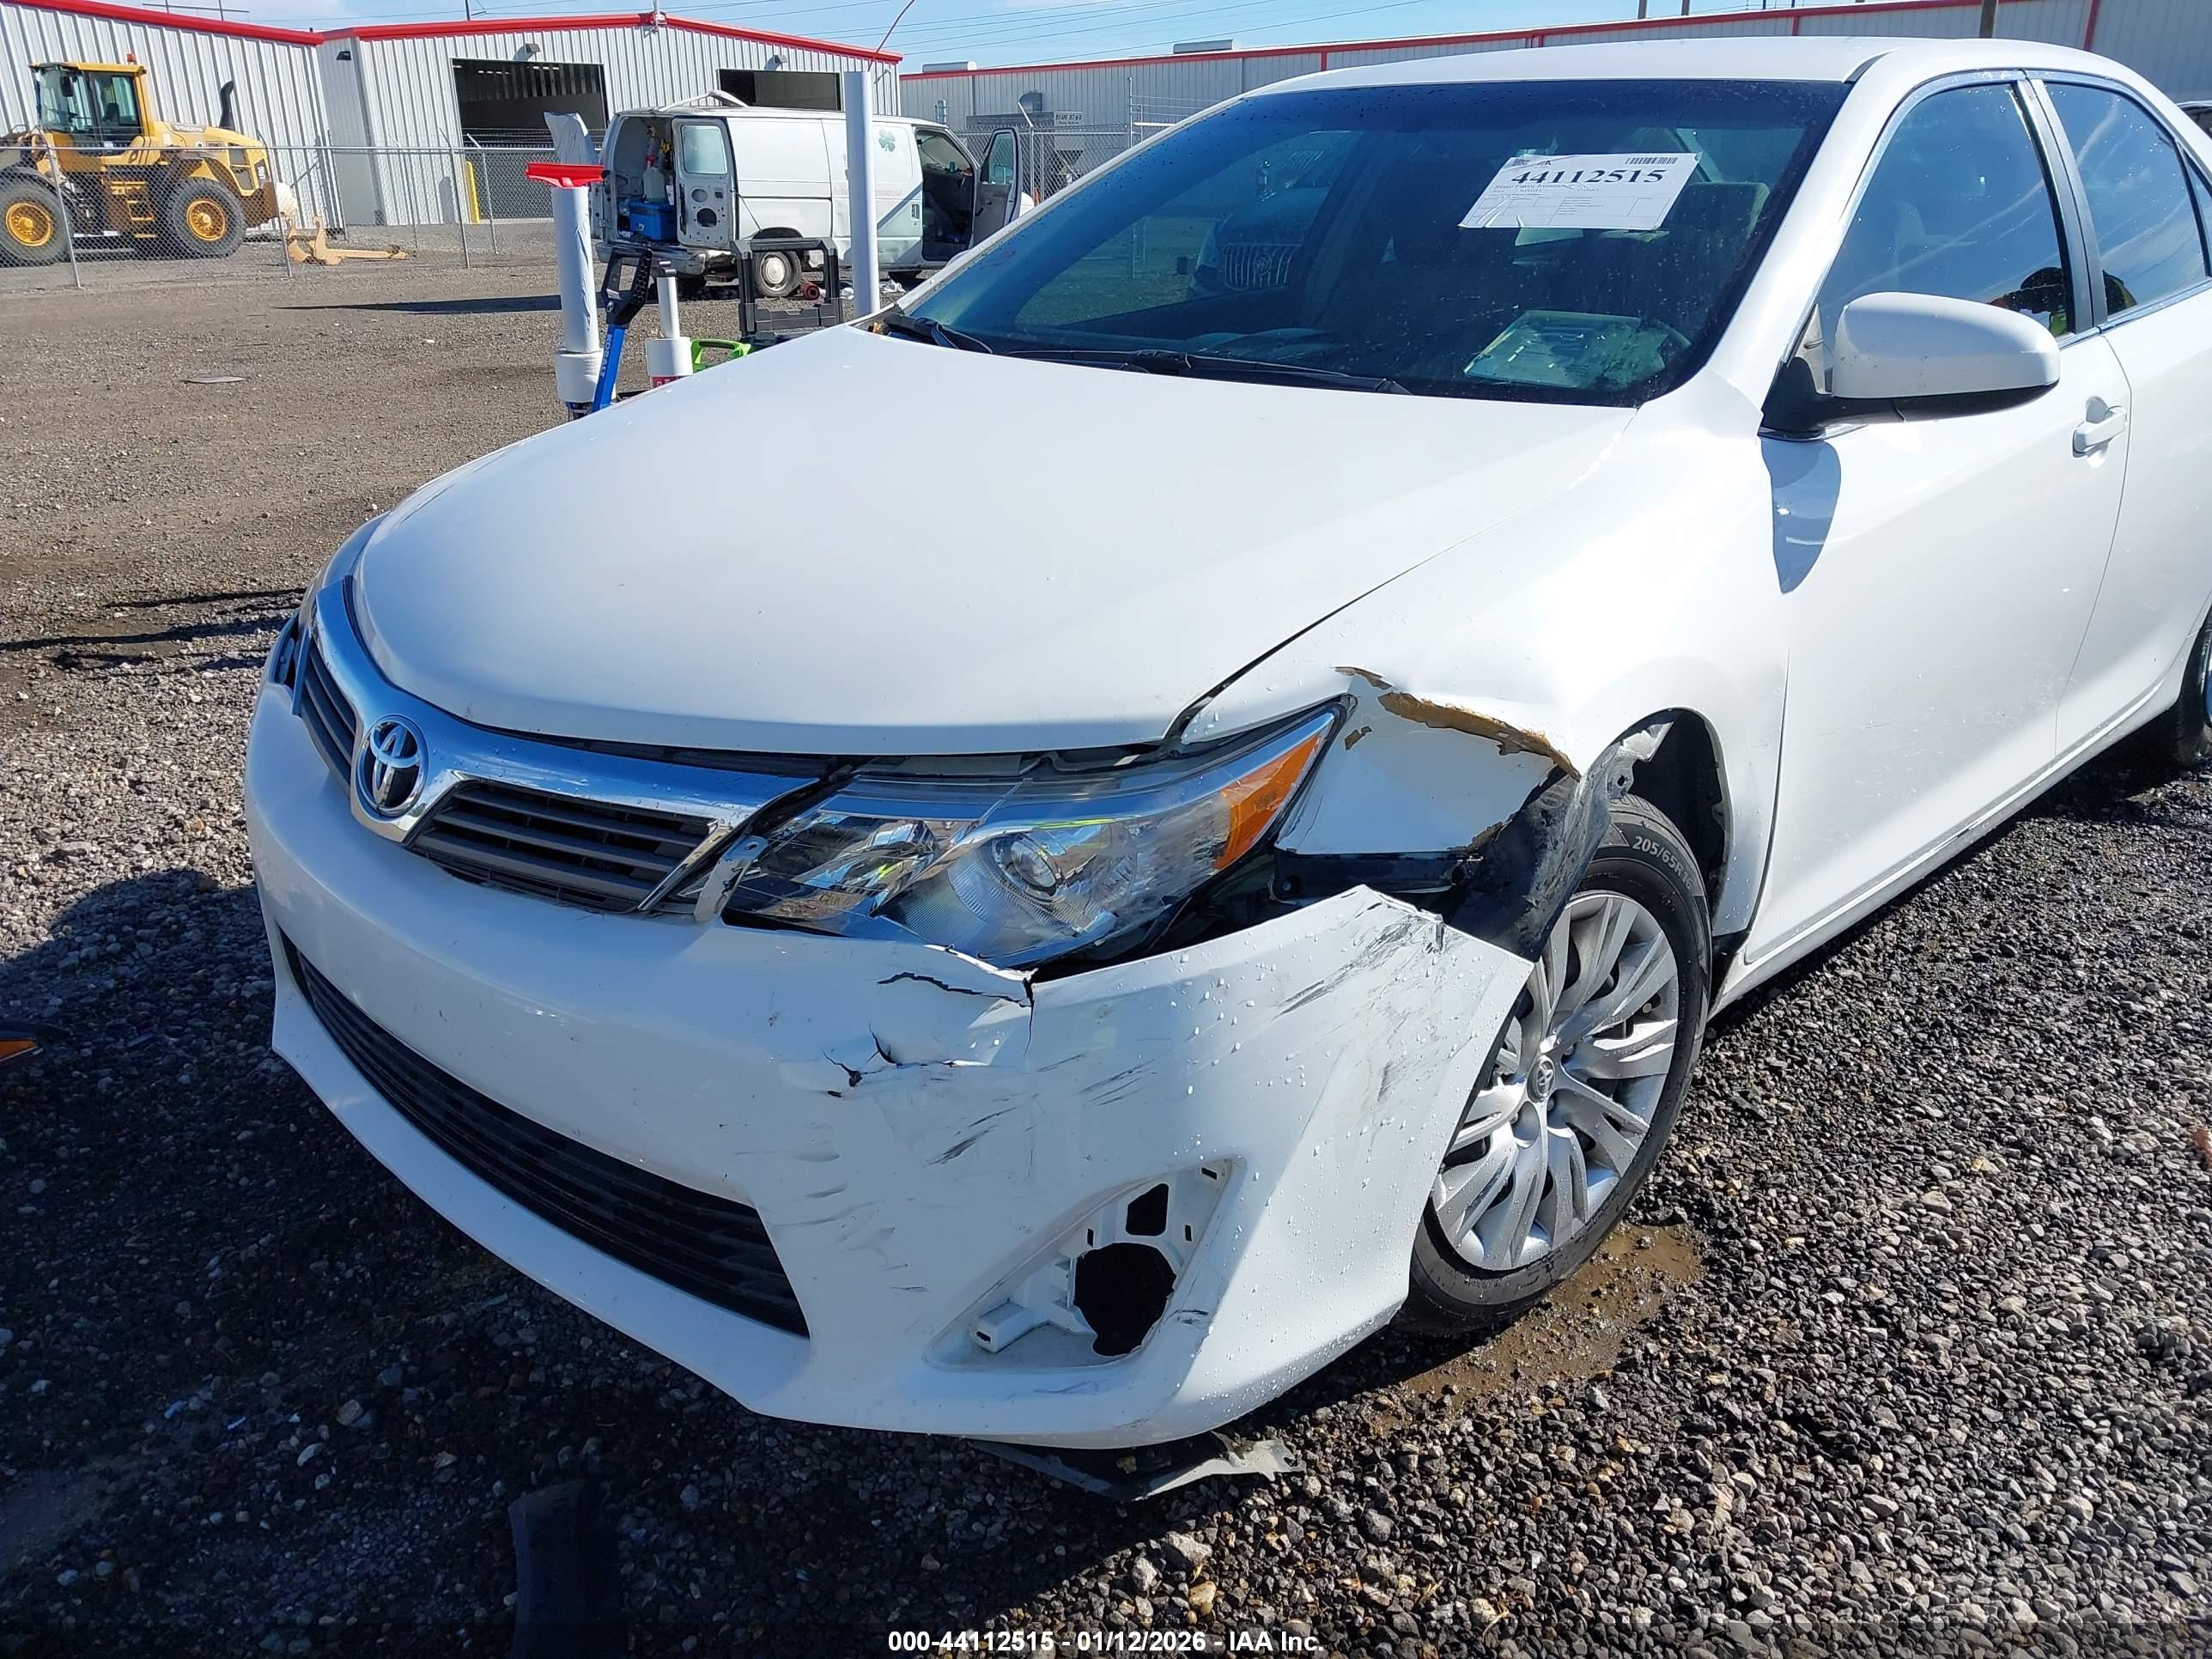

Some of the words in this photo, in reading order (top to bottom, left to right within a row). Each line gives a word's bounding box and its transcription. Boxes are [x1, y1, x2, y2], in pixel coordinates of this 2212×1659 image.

[1511, 170, 1668, 184] 44112515
[600, 333, 613, 379] KOBALT
[1632, 836, 1694, 891] 205/65R16
